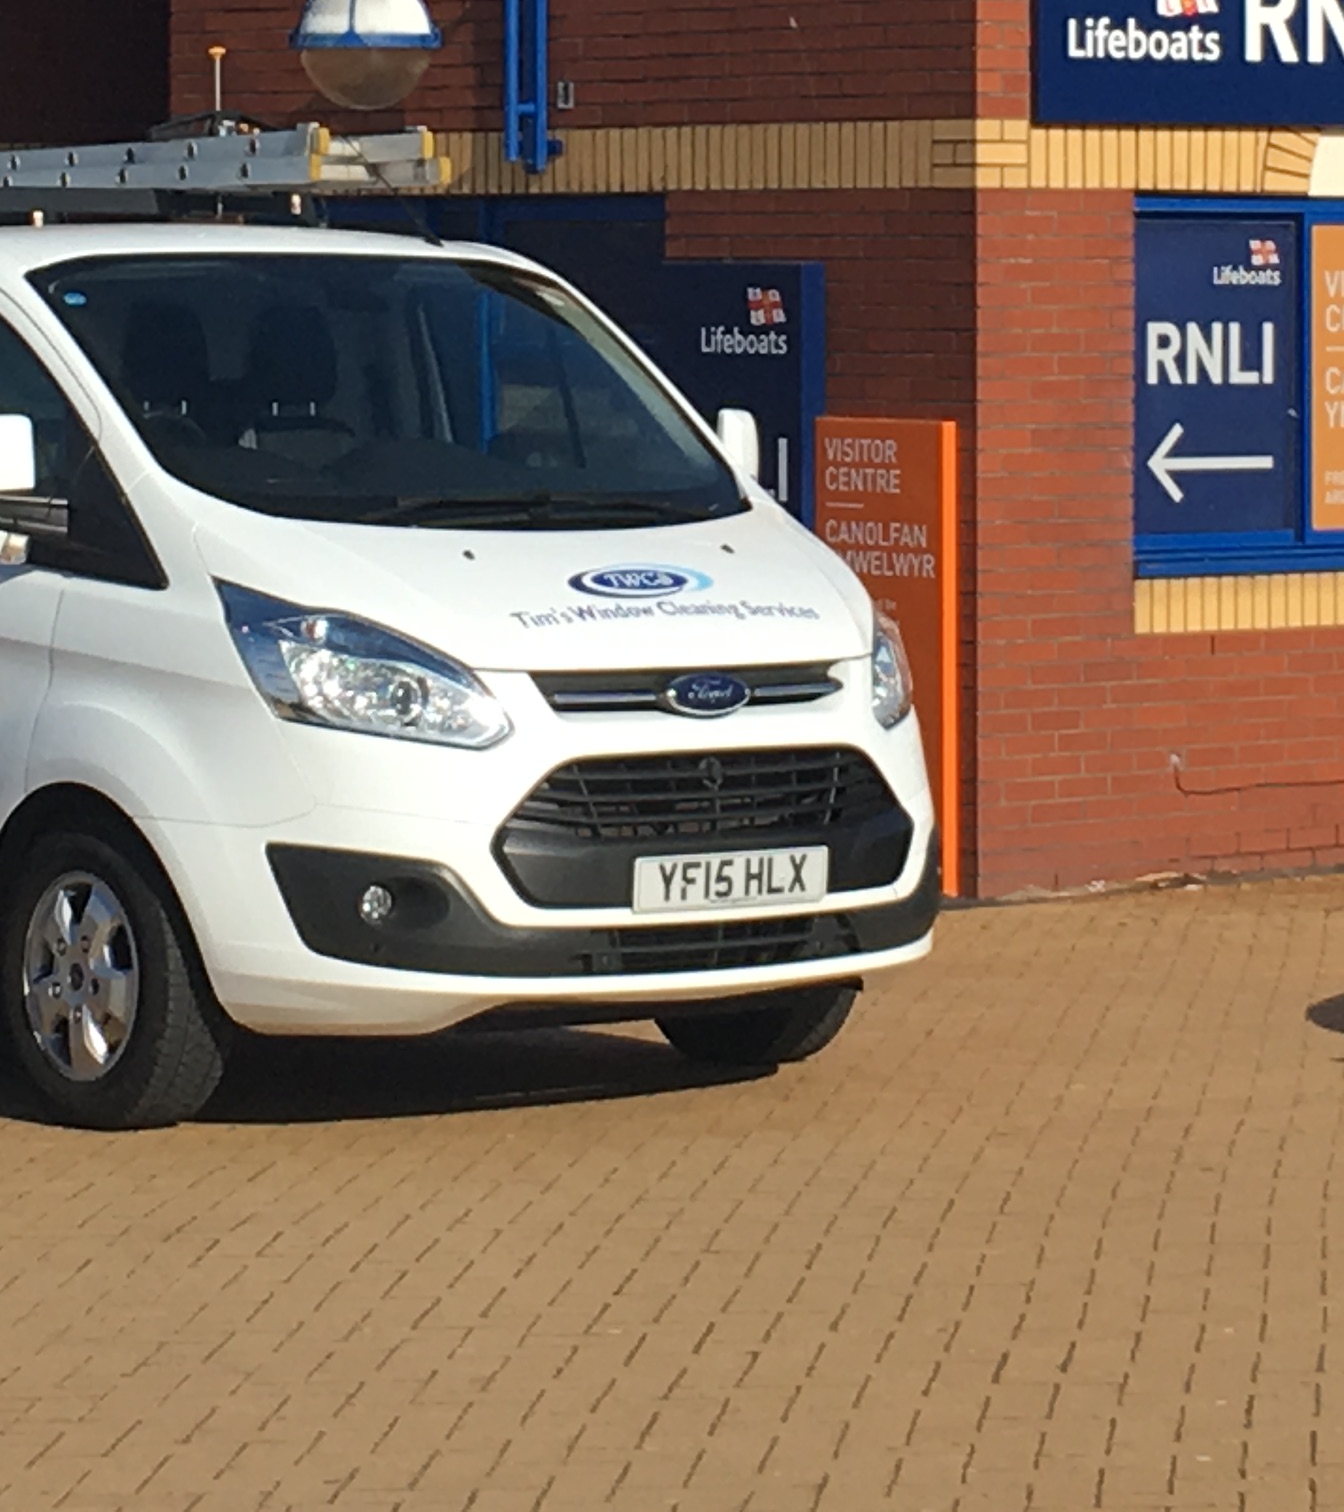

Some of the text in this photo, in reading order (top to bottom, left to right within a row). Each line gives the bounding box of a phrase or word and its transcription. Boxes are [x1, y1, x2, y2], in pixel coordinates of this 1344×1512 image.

[1067, 17, 1221, 61] Lifeboats
[1213, 265, 1282, 286] Lifeboats
[701, 325, 787, 354] Lifeboats
[1146, 321, 1274, 385] RNLI
[824, 437, 898, 464] VISITOR
[825, 466, 901, 494] CENTRE
[825, 518, 928, 548] CANOLFAN
[840, 550, 936, 579] WELWYR
[509, 599, 821, 630] Tim's Window Cleaning Services
[688, 678, 735, 705] Ford
[659, 854, 808, 903] YF15 HLX
